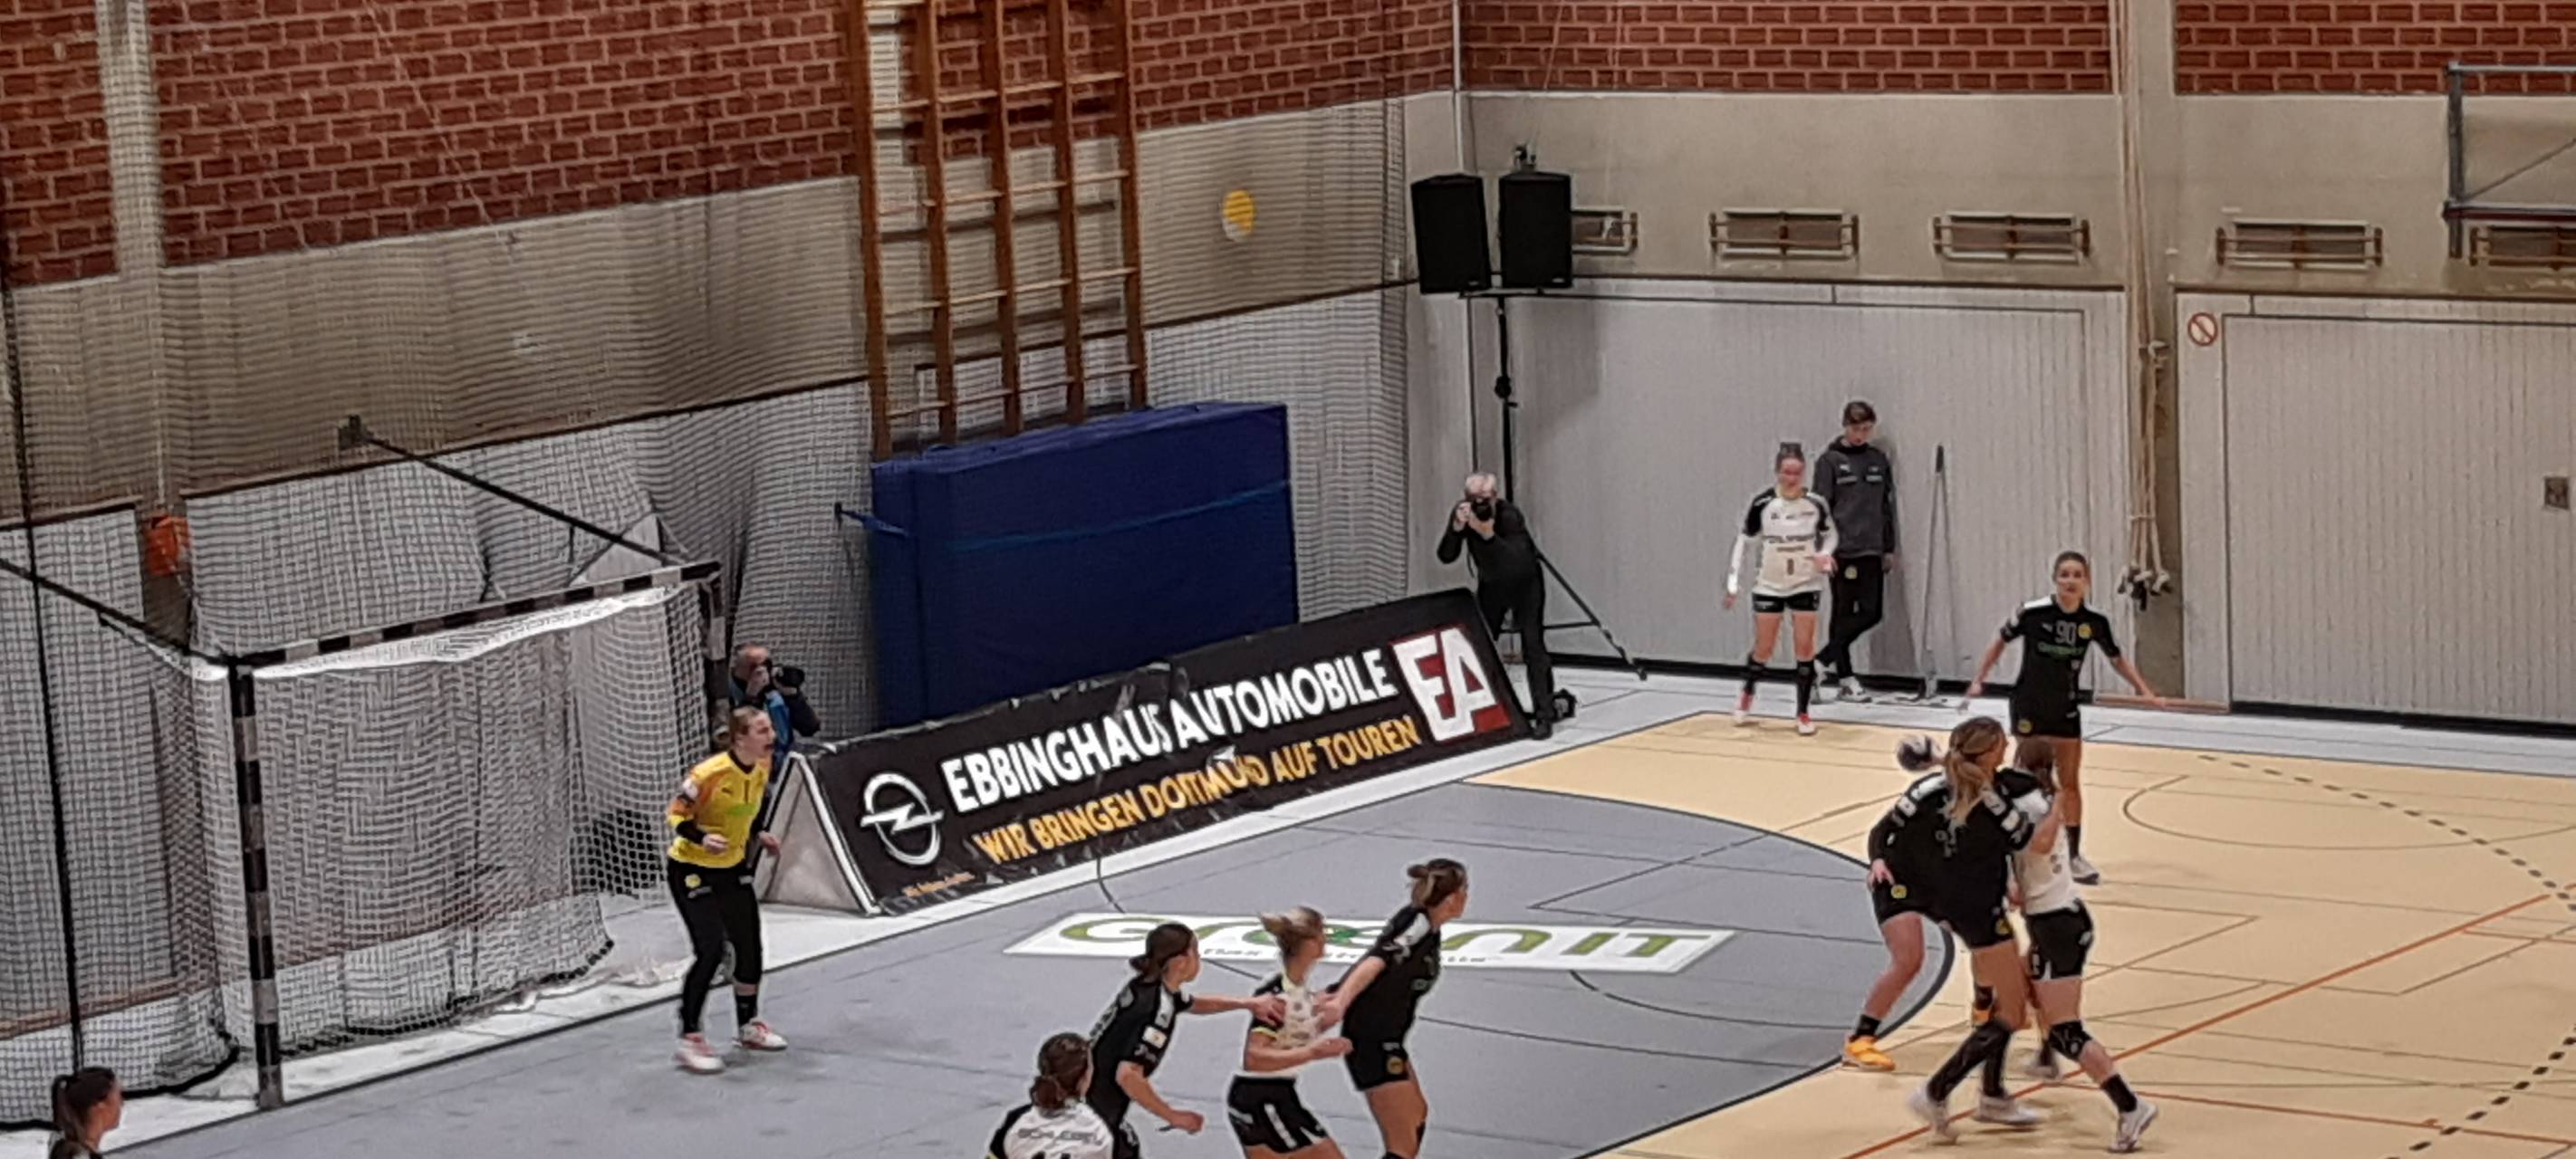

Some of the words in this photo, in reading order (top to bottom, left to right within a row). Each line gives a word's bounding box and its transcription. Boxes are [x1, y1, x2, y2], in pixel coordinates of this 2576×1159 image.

[1392, 627, 1496, 742] EA
[2054, 619, 2077, 646] 90
[940, 704, 1174, 813] EBBINGHAUS
[1168, 647, 1399, 749] AUTOMOBILE
[972, 822, 1038, 865] WIR
[1028, 789, 1148, 850] BRINGEN
[1138, 755, 1271, 819] DOTMUD
[1270, 744, 1319, 783] AUF
[1317, 714, 1423, 770] TOUREN
[1560, 933, 1712, 958] IT
